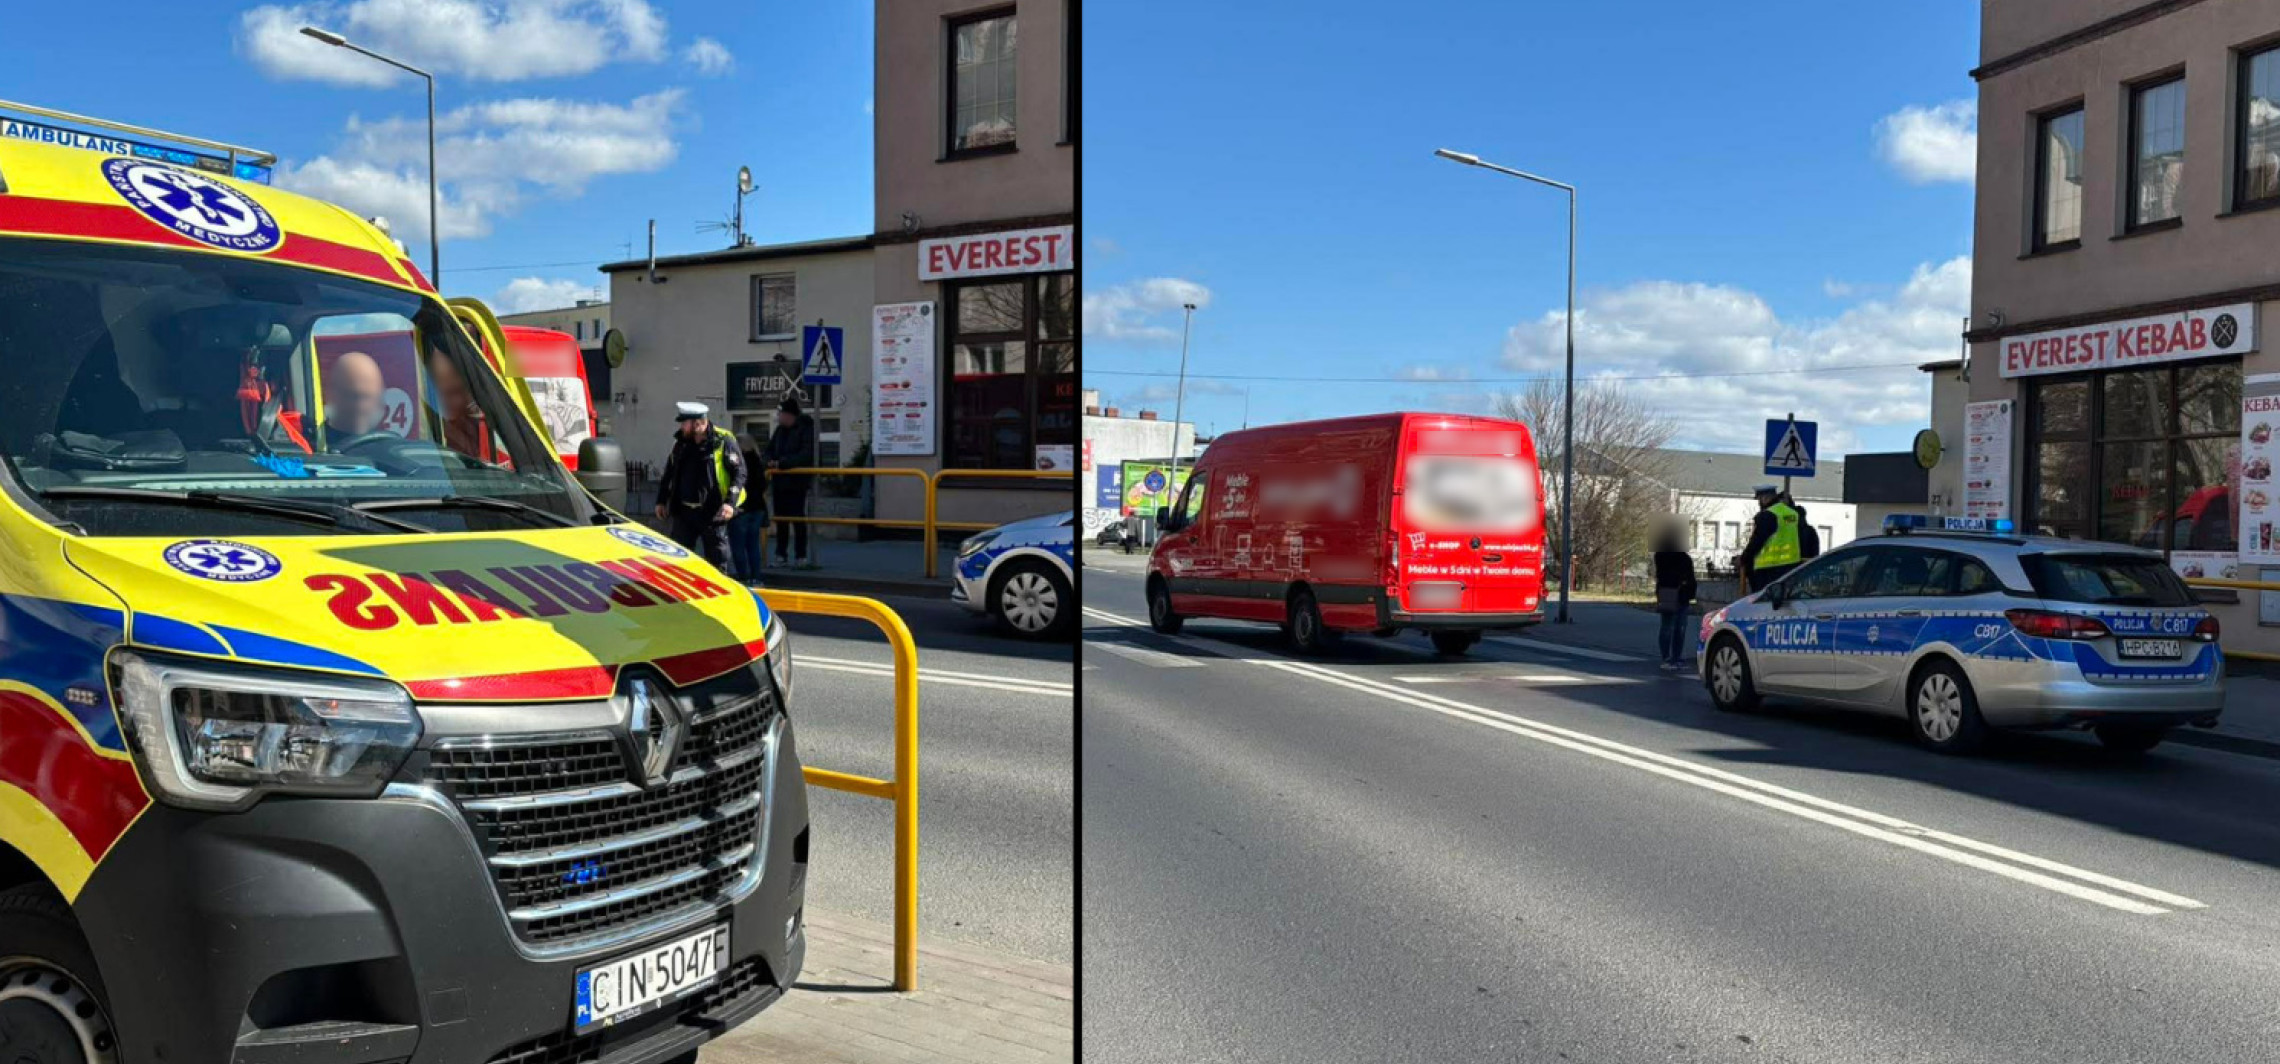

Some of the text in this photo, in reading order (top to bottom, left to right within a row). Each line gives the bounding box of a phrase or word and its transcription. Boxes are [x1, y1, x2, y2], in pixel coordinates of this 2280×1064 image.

[6, 121, 128, 155] AMBULANS
[929, 234, 1062, 273] EVEREST
[2007, 318, 2207, 371] EVEREST KEBAB
[1948, 518, 1984, 530] POLICJA
[1408, 564, 1438, 574] Meble
[1482, 565, 1510, 575] Twoim
[1511, 566, 1535, 575] domu
[1974, 623, 2001, 639] C817
[2114, 618, 2145, 630] POLICJA
[1765, 623, 1818, 646] POLICJA
[593, 928, 726, 1012] CIN 5047F
[577, 1005, 590, 1017] PL
